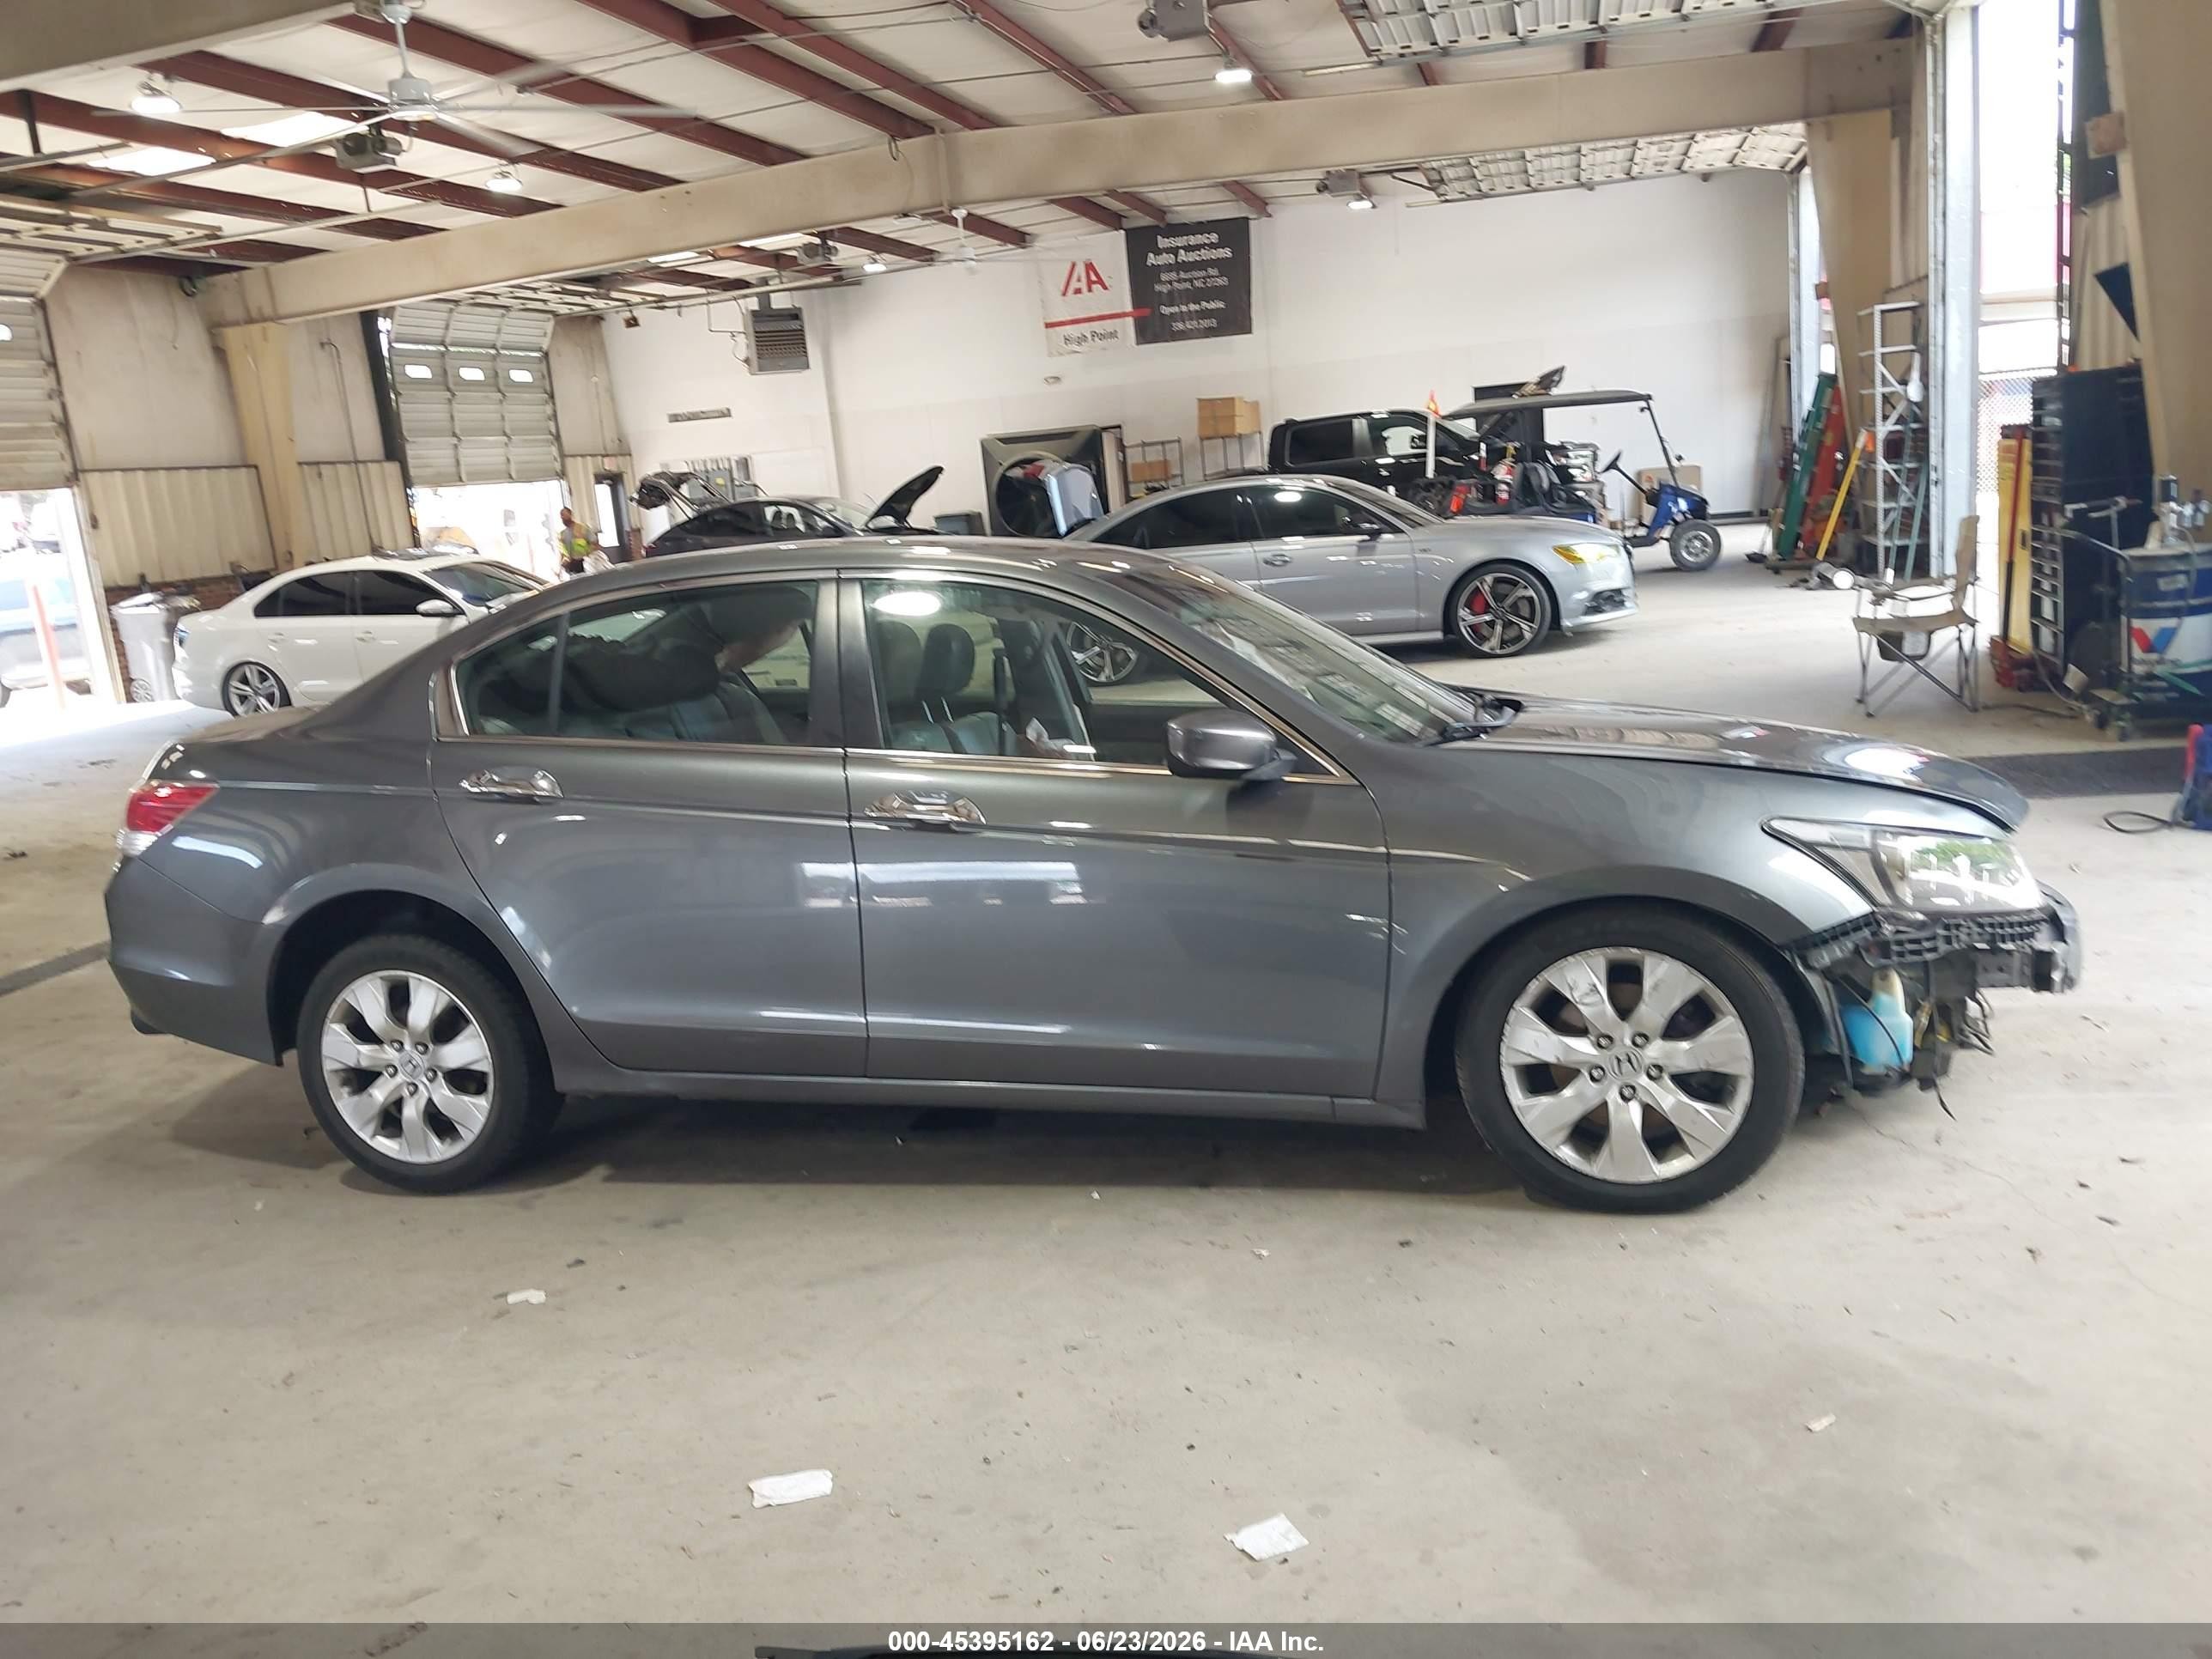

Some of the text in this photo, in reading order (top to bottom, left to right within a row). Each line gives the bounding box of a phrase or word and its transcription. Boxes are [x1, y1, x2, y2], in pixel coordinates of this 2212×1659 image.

[1157, 232, 1219, 249] Insurance
[1146, 246, 1233, 266] Auto Auctions
[1159, 299, 1227, 316] Open to the Public
[1063, 329, 1120, 347] High Point
